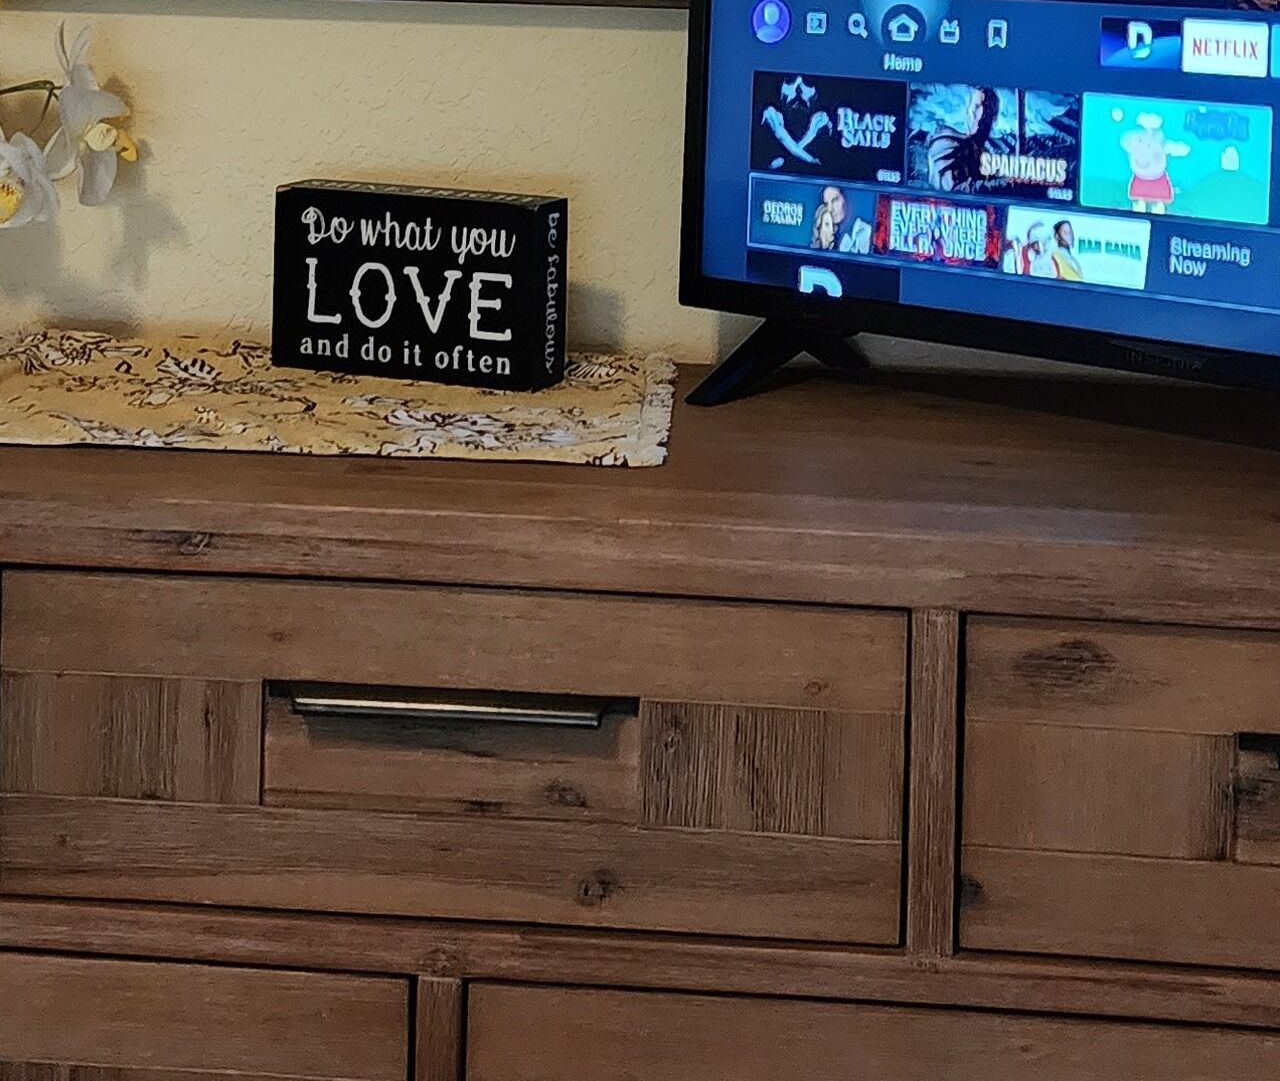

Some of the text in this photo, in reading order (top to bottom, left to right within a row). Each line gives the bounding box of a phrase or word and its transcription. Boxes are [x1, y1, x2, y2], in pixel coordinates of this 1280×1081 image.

[883, 53, 922, 72] Home
[1192, 37, 1259, 60] NETFLIX
[837, 107, 896, 133] BLACK
[980, 151, 1067, 183] SPARTACUS
[301, 206, 516, 264] Do what you
[1171, 237, 1250, 266] Streaming
[1171, 256, 1206, 276] Now
[305, 257, 513, 341] LOVE
[545, 211, 561, 374] be fabulous
[300, 334, 511, 375] and do it often
